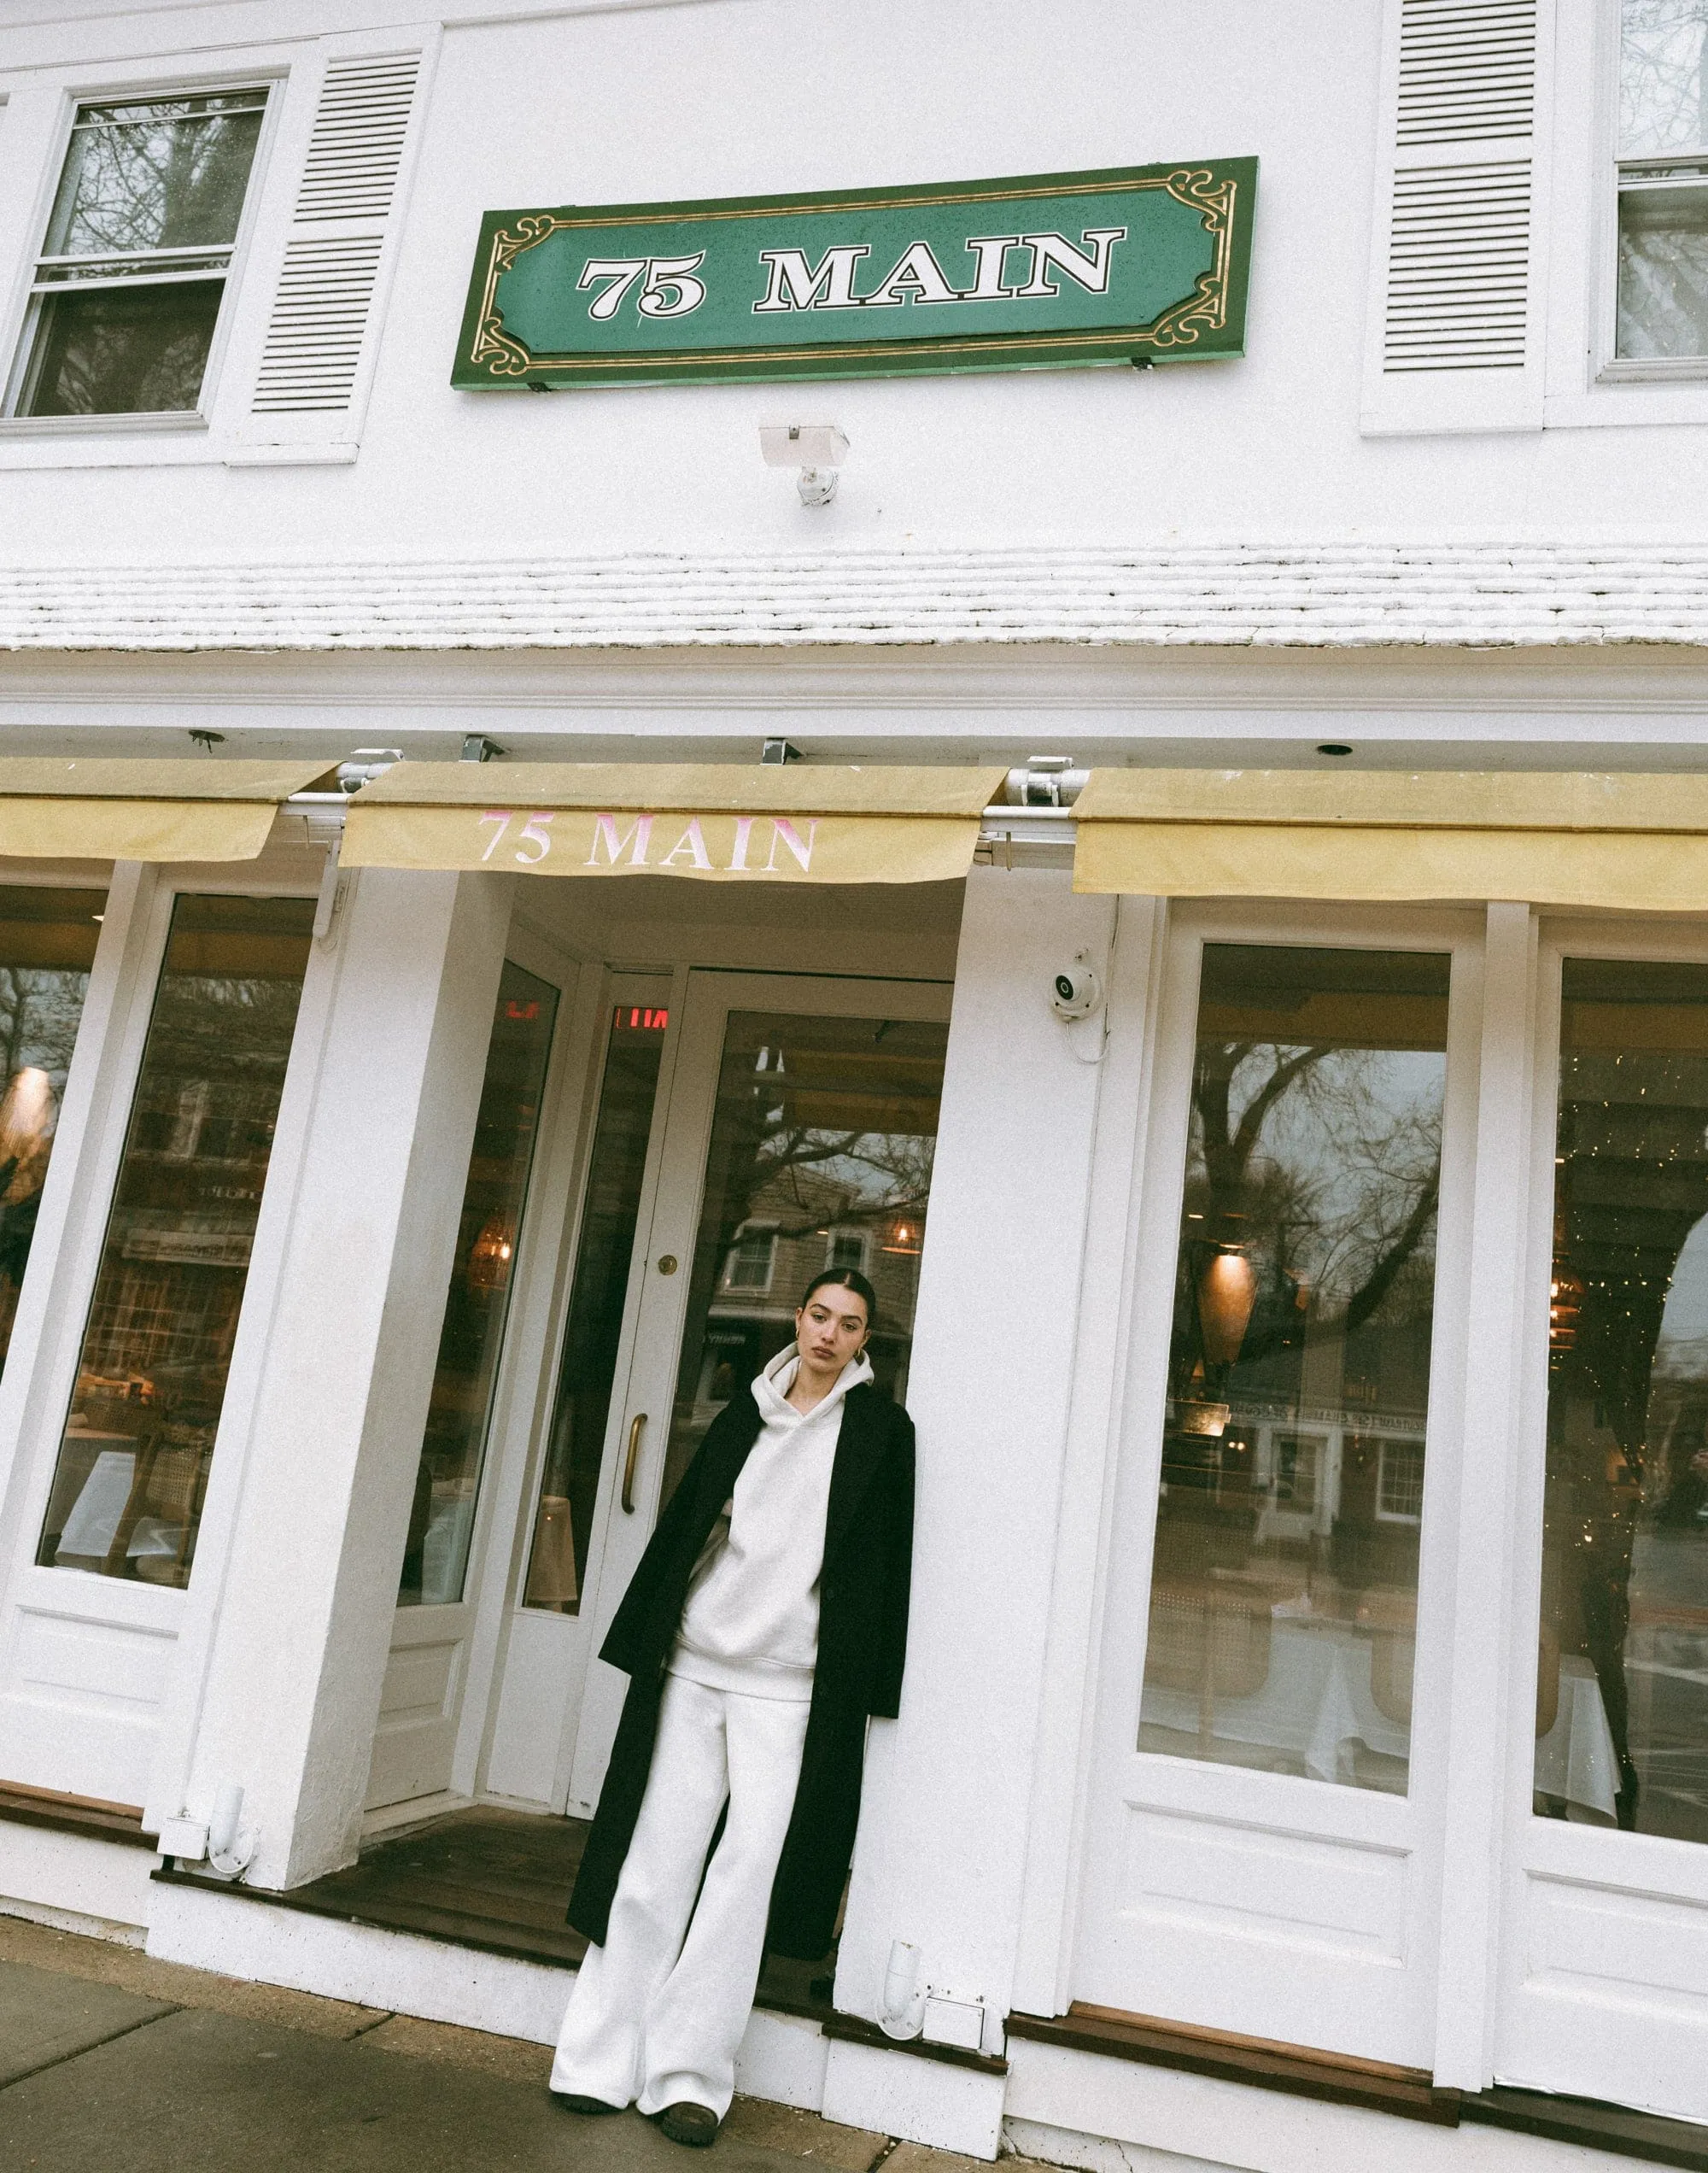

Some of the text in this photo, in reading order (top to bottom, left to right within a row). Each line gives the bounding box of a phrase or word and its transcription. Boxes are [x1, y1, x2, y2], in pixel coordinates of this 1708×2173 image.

[576, 226, 1128, 321] 75 MAIN
[477, 811, 821, 872] 75 MAIN
